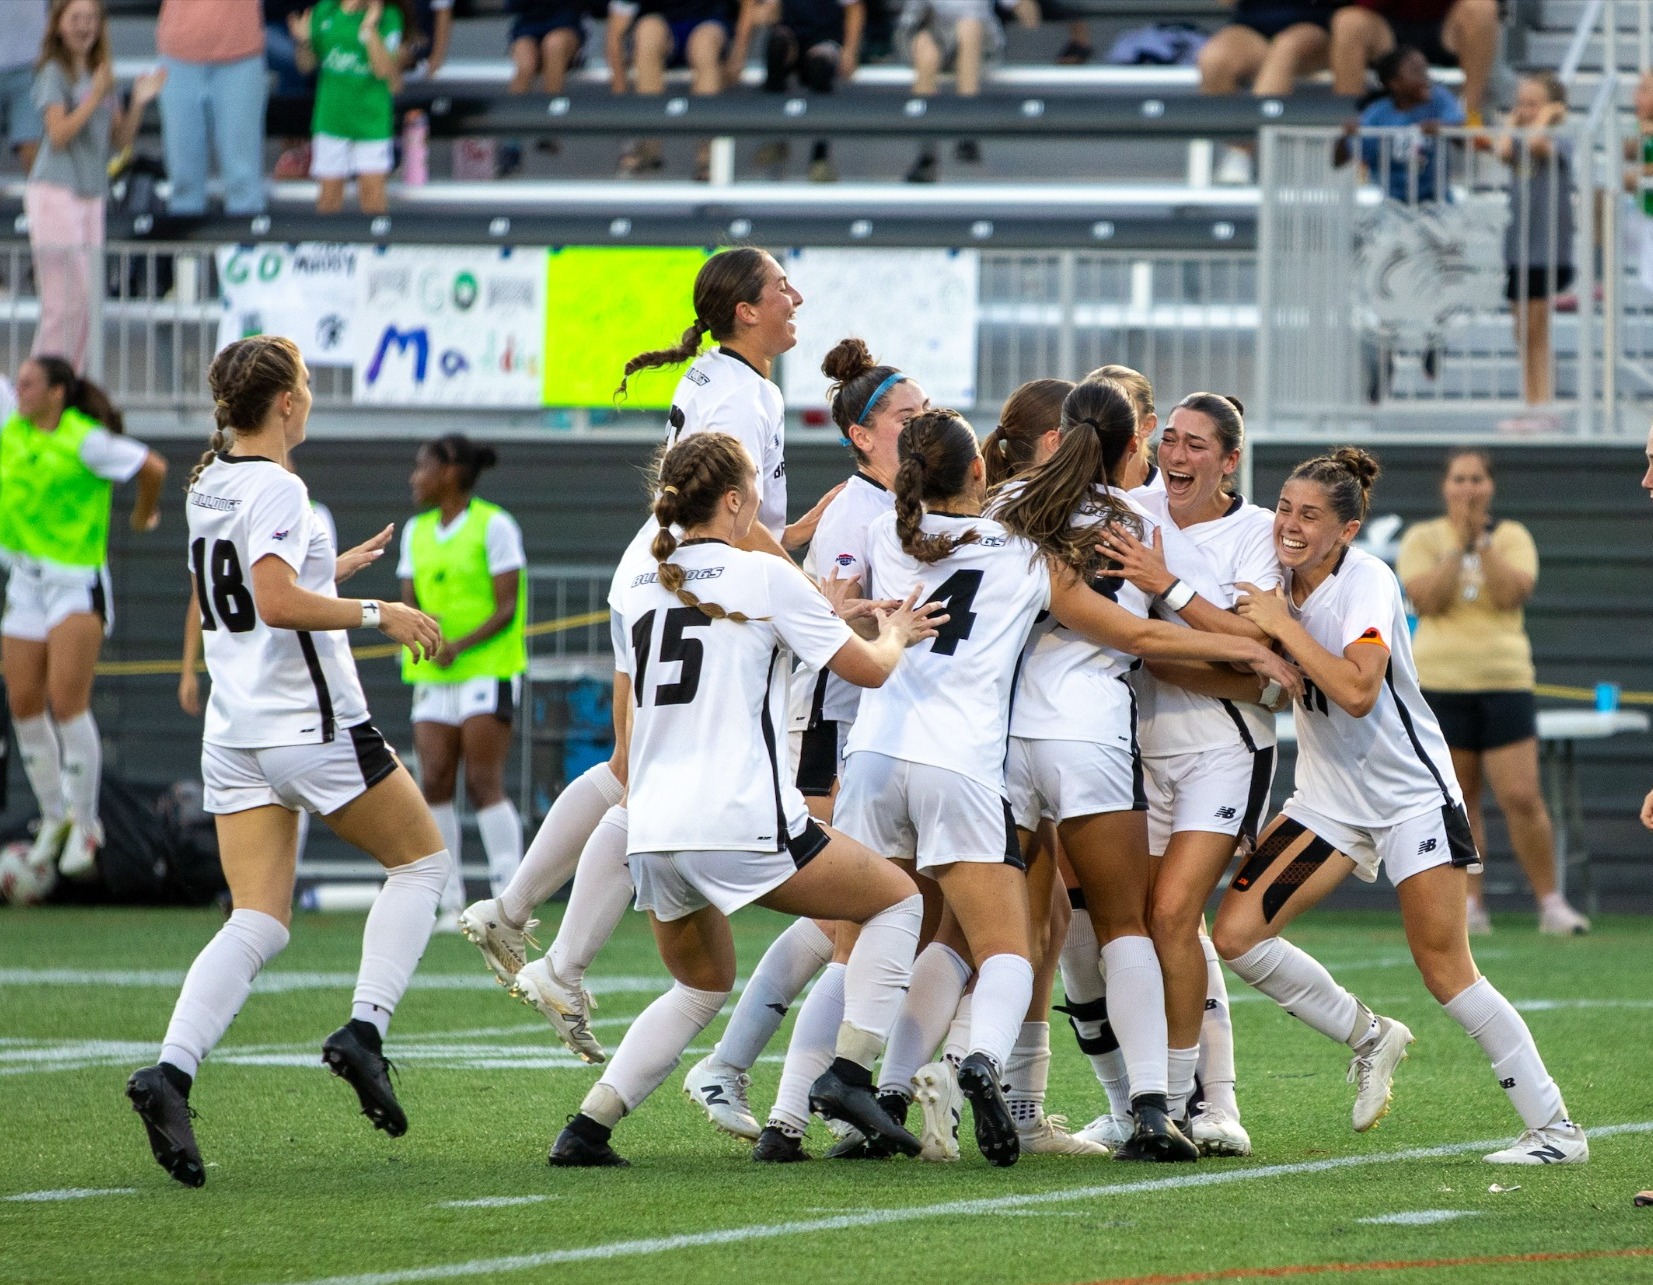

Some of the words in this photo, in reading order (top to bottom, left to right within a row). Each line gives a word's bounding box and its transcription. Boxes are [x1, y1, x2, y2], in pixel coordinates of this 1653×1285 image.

[191, 537, 256, 633] 18
[912, 568, 985, 657] 4
[631, 606, 712, 708] 15
